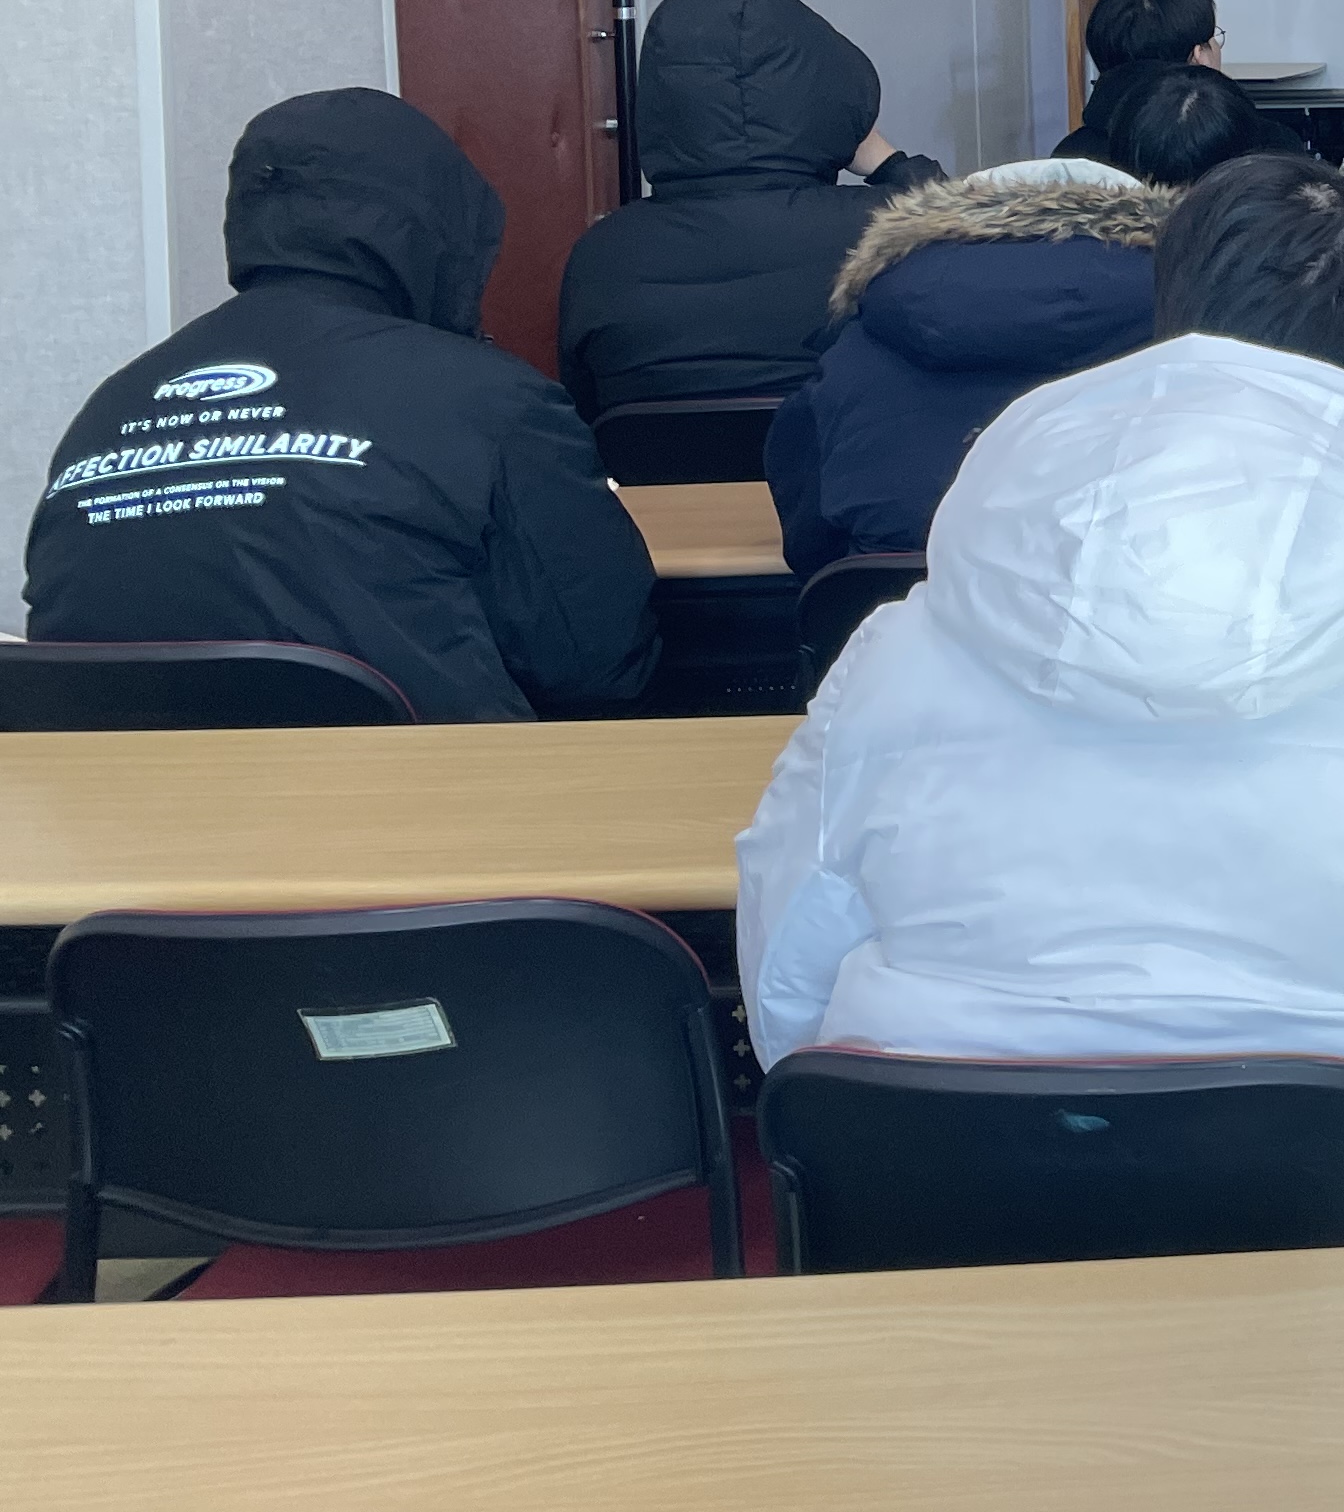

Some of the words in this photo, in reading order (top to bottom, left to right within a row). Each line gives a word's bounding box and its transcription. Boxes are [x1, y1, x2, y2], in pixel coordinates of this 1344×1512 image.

[153, 375, 248, 402] Progress
[120, 418, 152, 436] IT'S
[156, 412, 195, 429] NOW
[199, 409, 223, 424] OR
[227, 405, 288, 422] NEVER
[188, 433, 373, 460] SIMILARITY
[93, 490, 140, 506] FORMATION
[141, 488, 154, 498] OF
[155, 488, 162, 496] A
[163, 481, 214, 495] CONSENSUS
[215, 479, 230, 489] ON
[231, 478, 250, 487] THE
[251, 476, 286, 487] VISION
[87, 510, 112, 525] THE
[114, 504, 145, 520] TIME
[146, 503, 153, 514] I
[155, 497, 192, 513] LOOK
[195, 491, 266, 508] FORWARD
